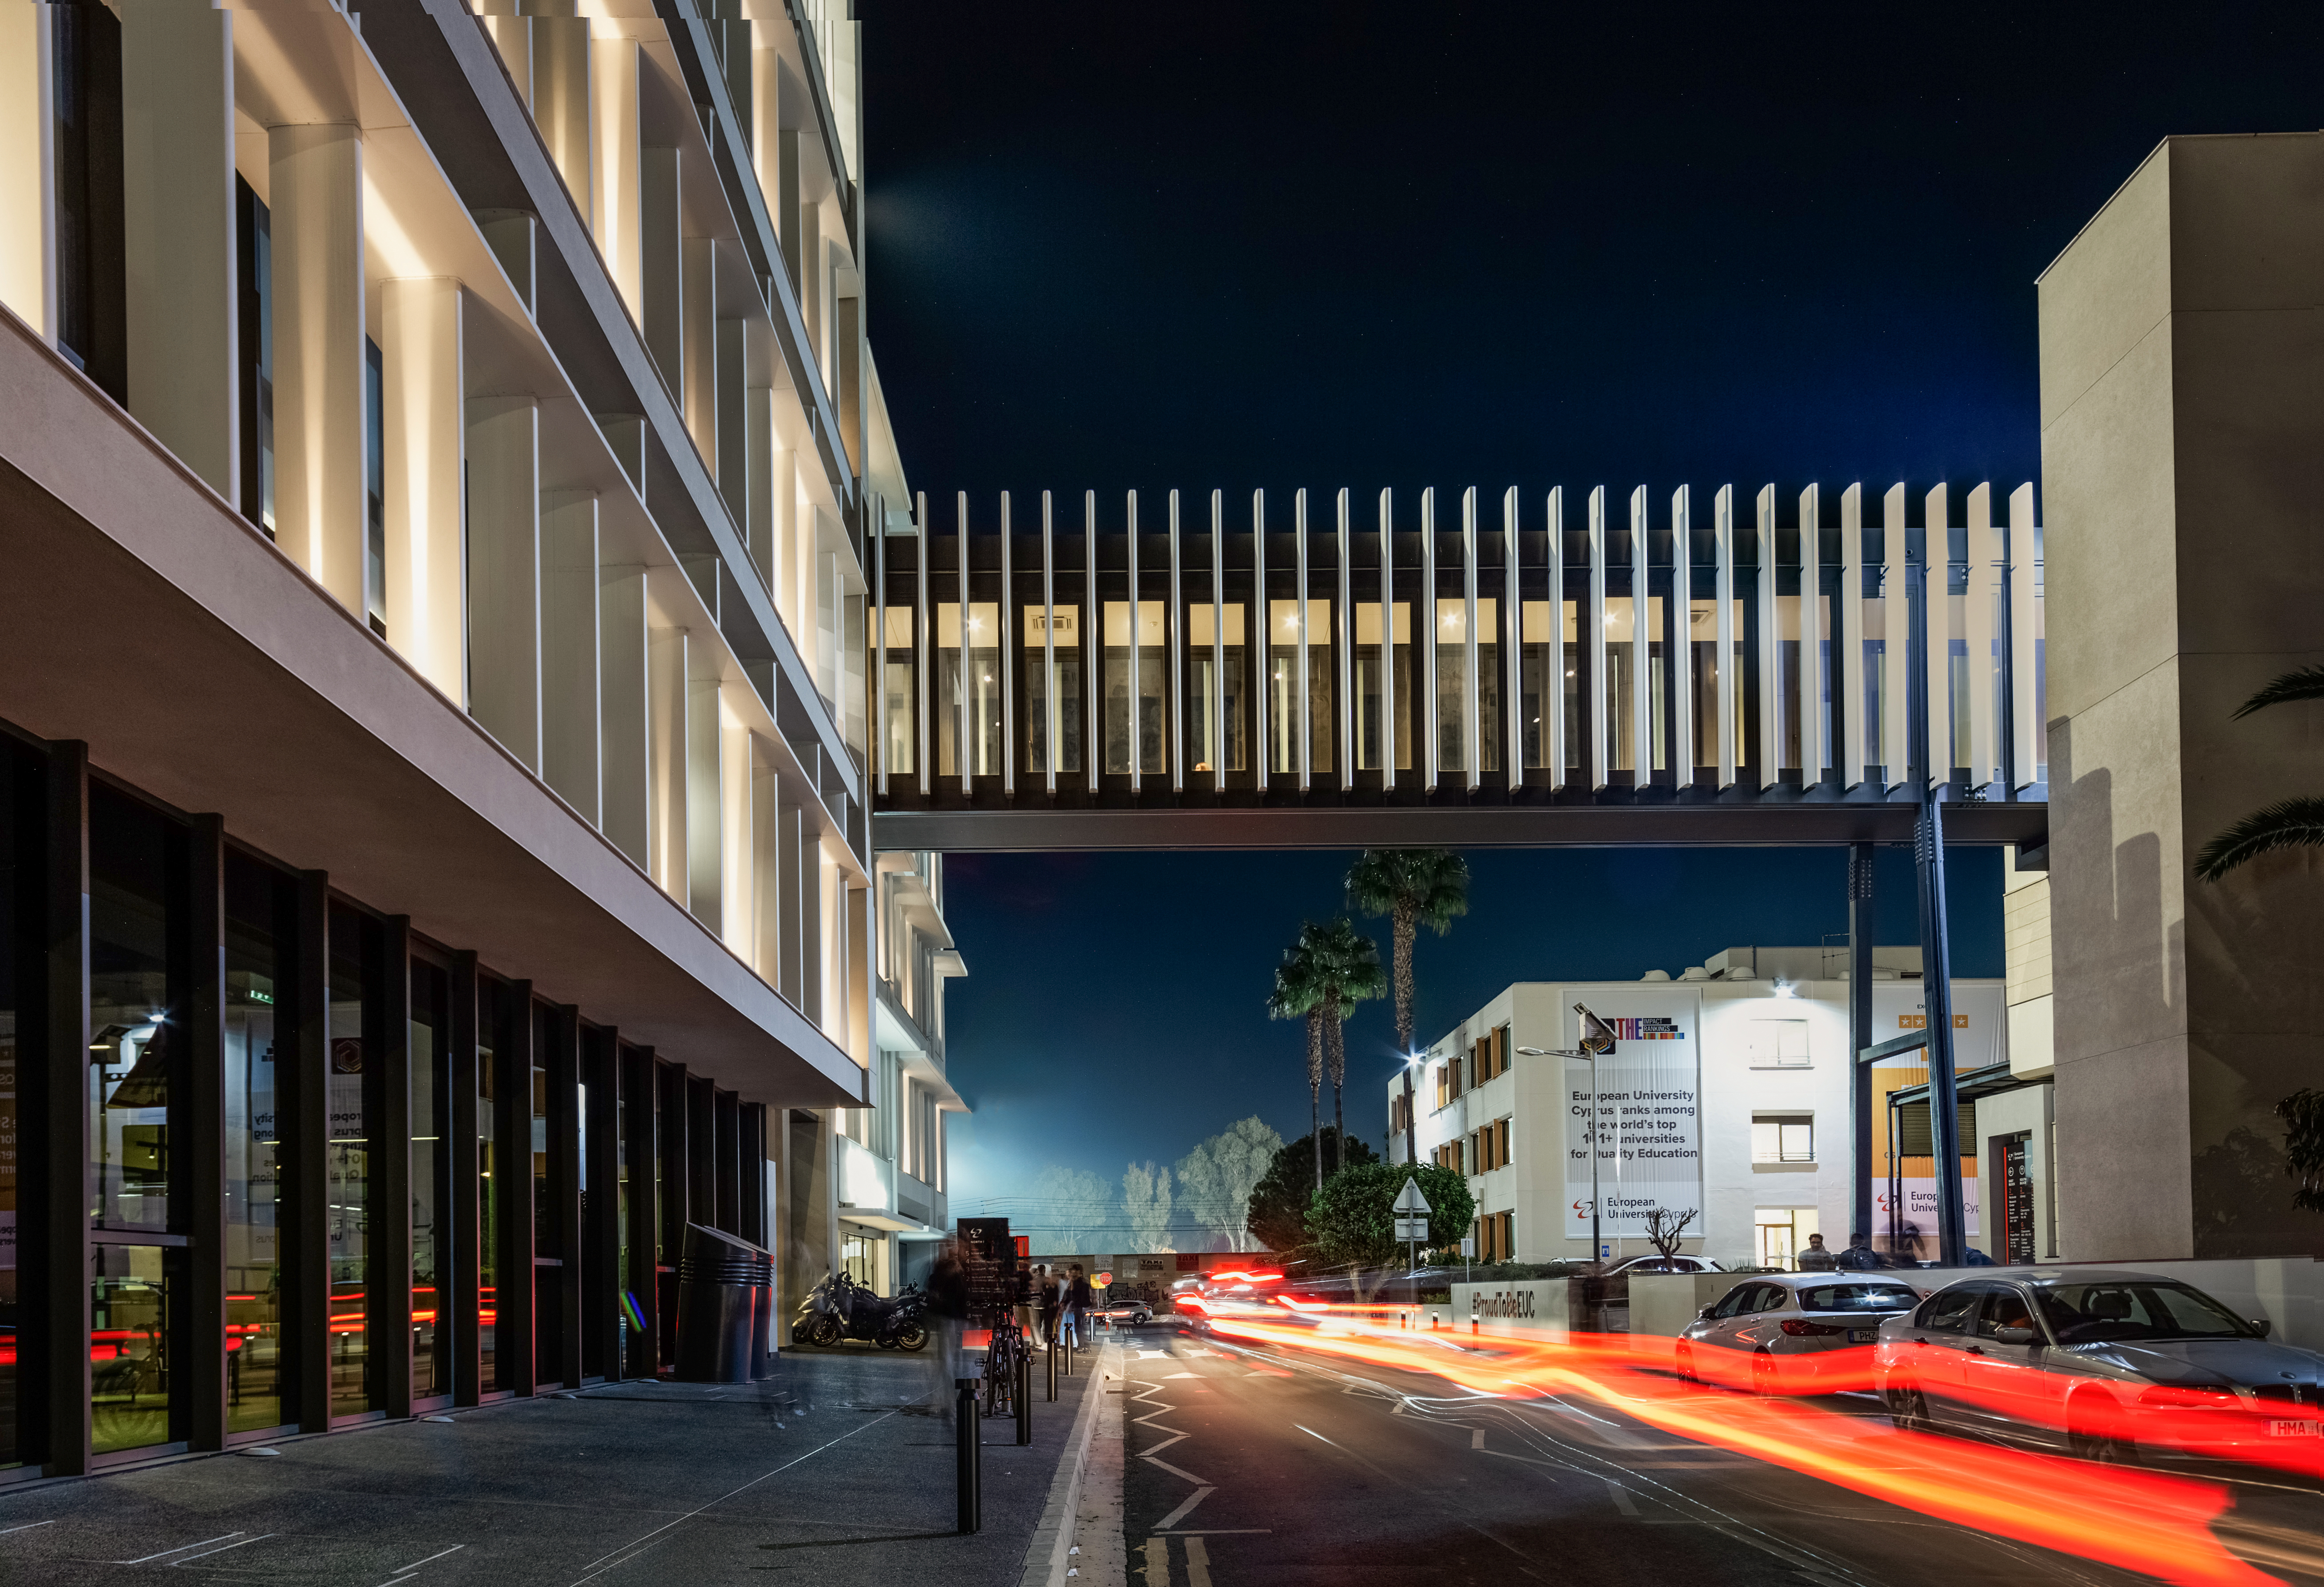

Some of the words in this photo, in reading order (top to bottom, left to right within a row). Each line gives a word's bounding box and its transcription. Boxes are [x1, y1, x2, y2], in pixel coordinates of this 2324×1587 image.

[1616, 1018, 1643, 1040] THE
[1572, 1091, 1629, 1103] Eurpean
[1633, 1090, 1694, 1101] University
[1571, 1106, 1614, 1117] Cypus
[1620, 1105, 1650, 1115] anks
[1654, 1107, 1695, 1116] among
[1657, 1120, 1677, 1131] top
[1571, 1149, 1588, 1159] for
[1598, 1148, 1635, 1160] uaity
[1638, 1148, 1698, 1158] Education
[1911, 1191, 1937, 1202] Europ
[1608, 1198, 1655, 1208] European
[1912, 1203, 1938, 1212] Unive
[1473, 1290, 1535, 1318] #ProudToBeEUC
[2278, 1422, 2306, 1435] HMA
